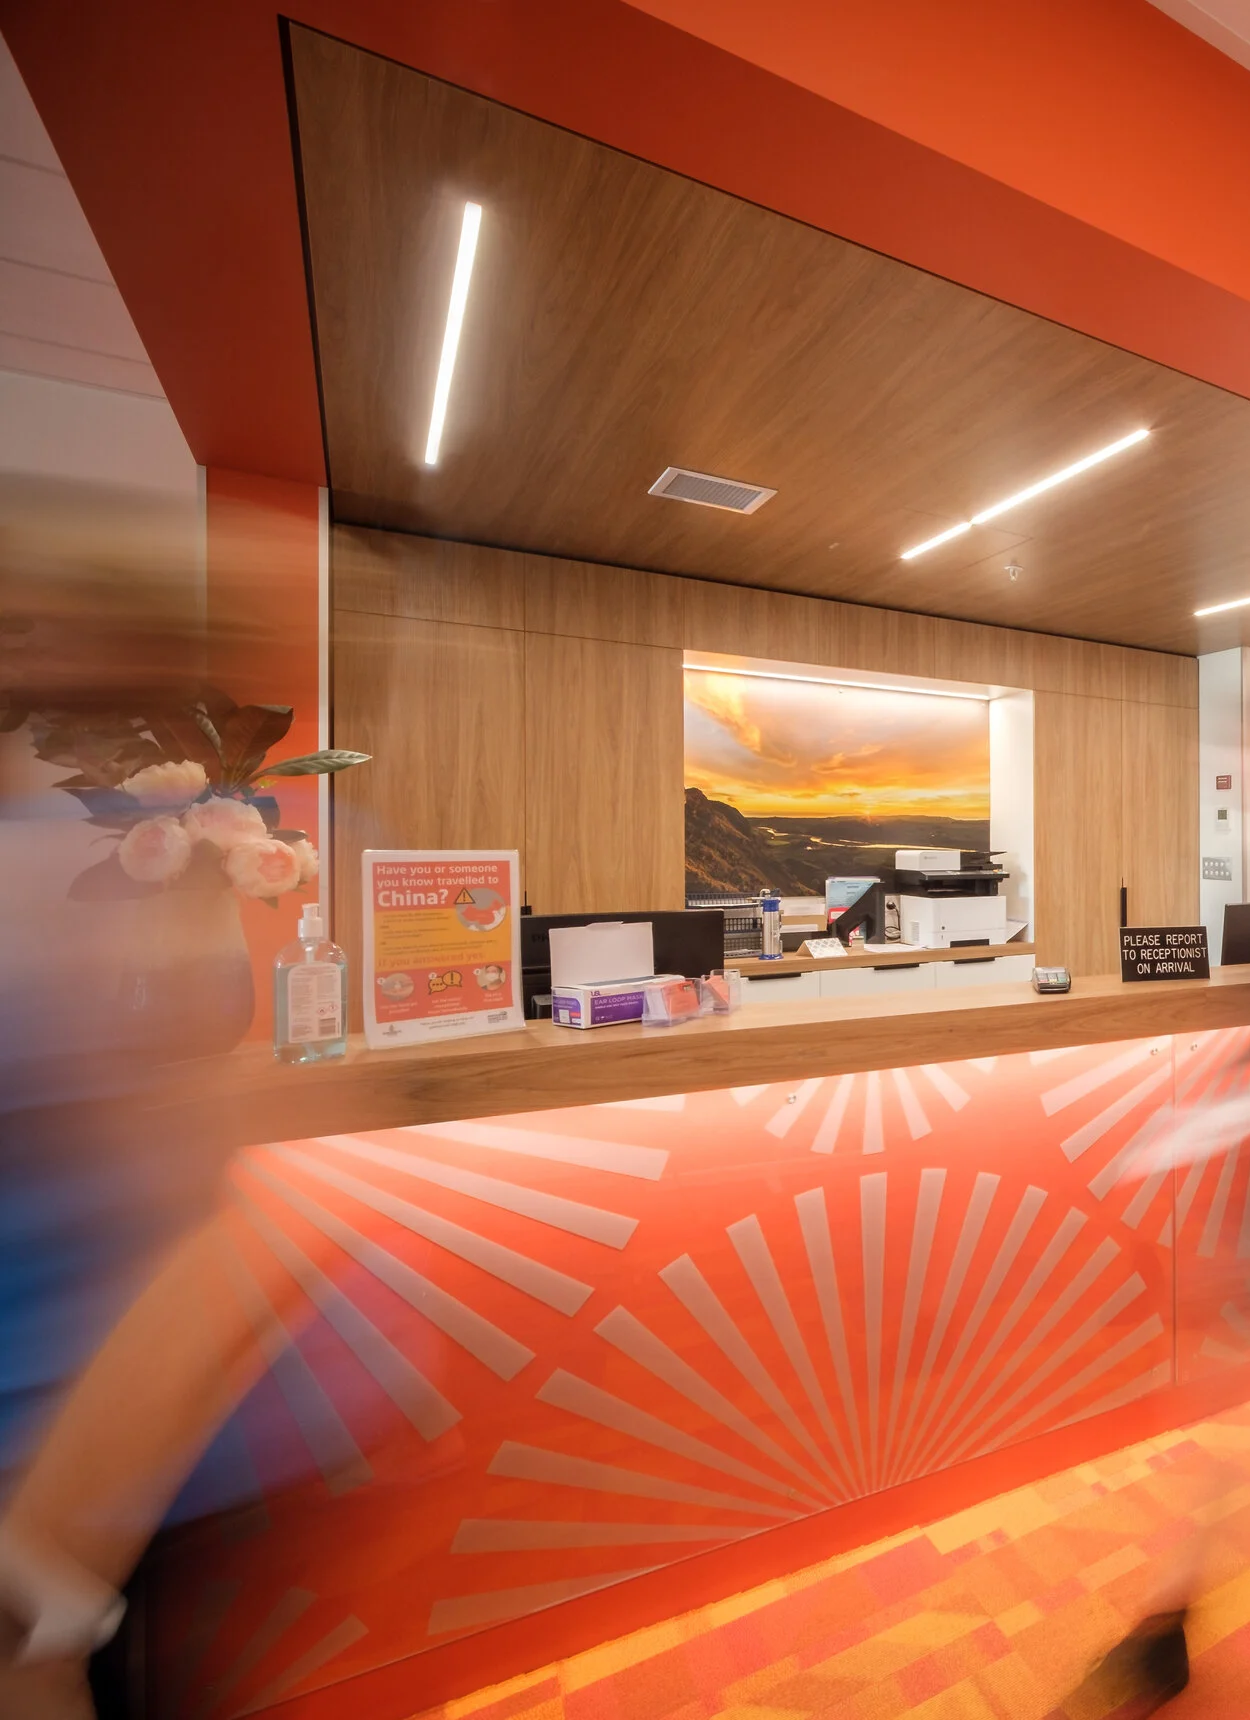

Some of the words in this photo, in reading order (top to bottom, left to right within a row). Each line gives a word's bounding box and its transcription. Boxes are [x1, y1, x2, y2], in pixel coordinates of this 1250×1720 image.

[376, 865, 407, 875] Have
[410, 865, 431, 876] you
[434, 864, 446, 874] or
[448, 865, 498, 873] someone
[377, 880, 399, 889] you
[402, 877, 434, 887] know
[437, 876, 485, 886] travelled
[488, 876, 499, 884] to
[377, 888, 449, 907] China?
[1123, 935, 1160, 946] PLEASE
[1165, 933, 1203, 945] REPORT
[1122, 949, 1137, 960] TO
[1140, 947, 1206, 959] RECEPTIONIST
[390, 958, 410, 969] you
[1136, 963, 1151, 974] ON
[1155, 962, 1195, 974] ARRIVAL
